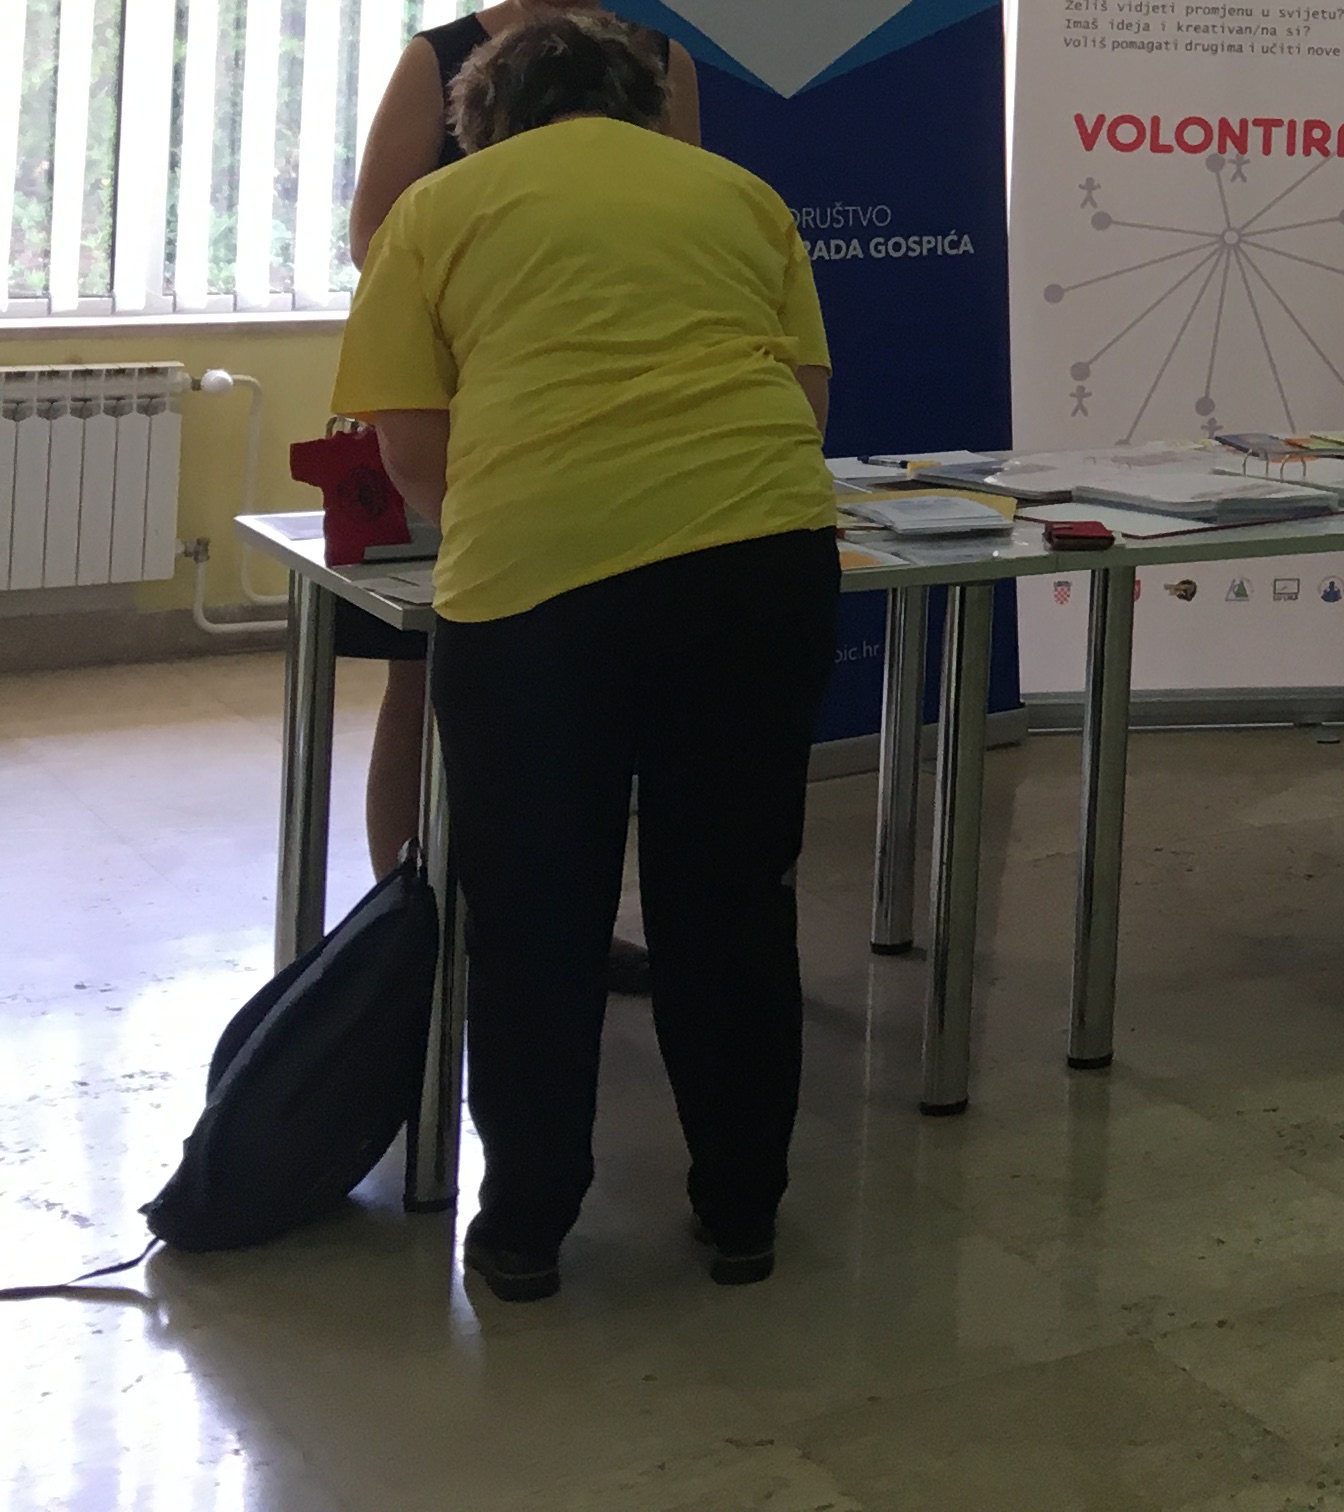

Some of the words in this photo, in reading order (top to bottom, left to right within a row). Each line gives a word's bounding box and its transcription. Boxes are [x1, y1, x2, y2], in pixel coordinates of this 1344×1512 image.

[1117, 1, 1175, 17] vidjeti
[1185, 3, 1253, 17] promjenu
[1261, 8, 1270, 18] u
[1279, 6, 1344, 22] svijetu?
[1065, 18, 1099, 30] Imaš
[1109, 19, 1150, 34] ideja
[1177, 21, 1277, 37] kreativan/na
[1286, 25, 1311, 37] si?
[1063, 36, 1107, 49] Voliš
[1111, 39, 1178, 53] pomagati
[1184, 40, 1243, 55] drugima
[1261, 43, 1301, 55] učiti
[1307, 46, 1341, 57] nove
[869, 229, 975, 259] GOSPIĆA
